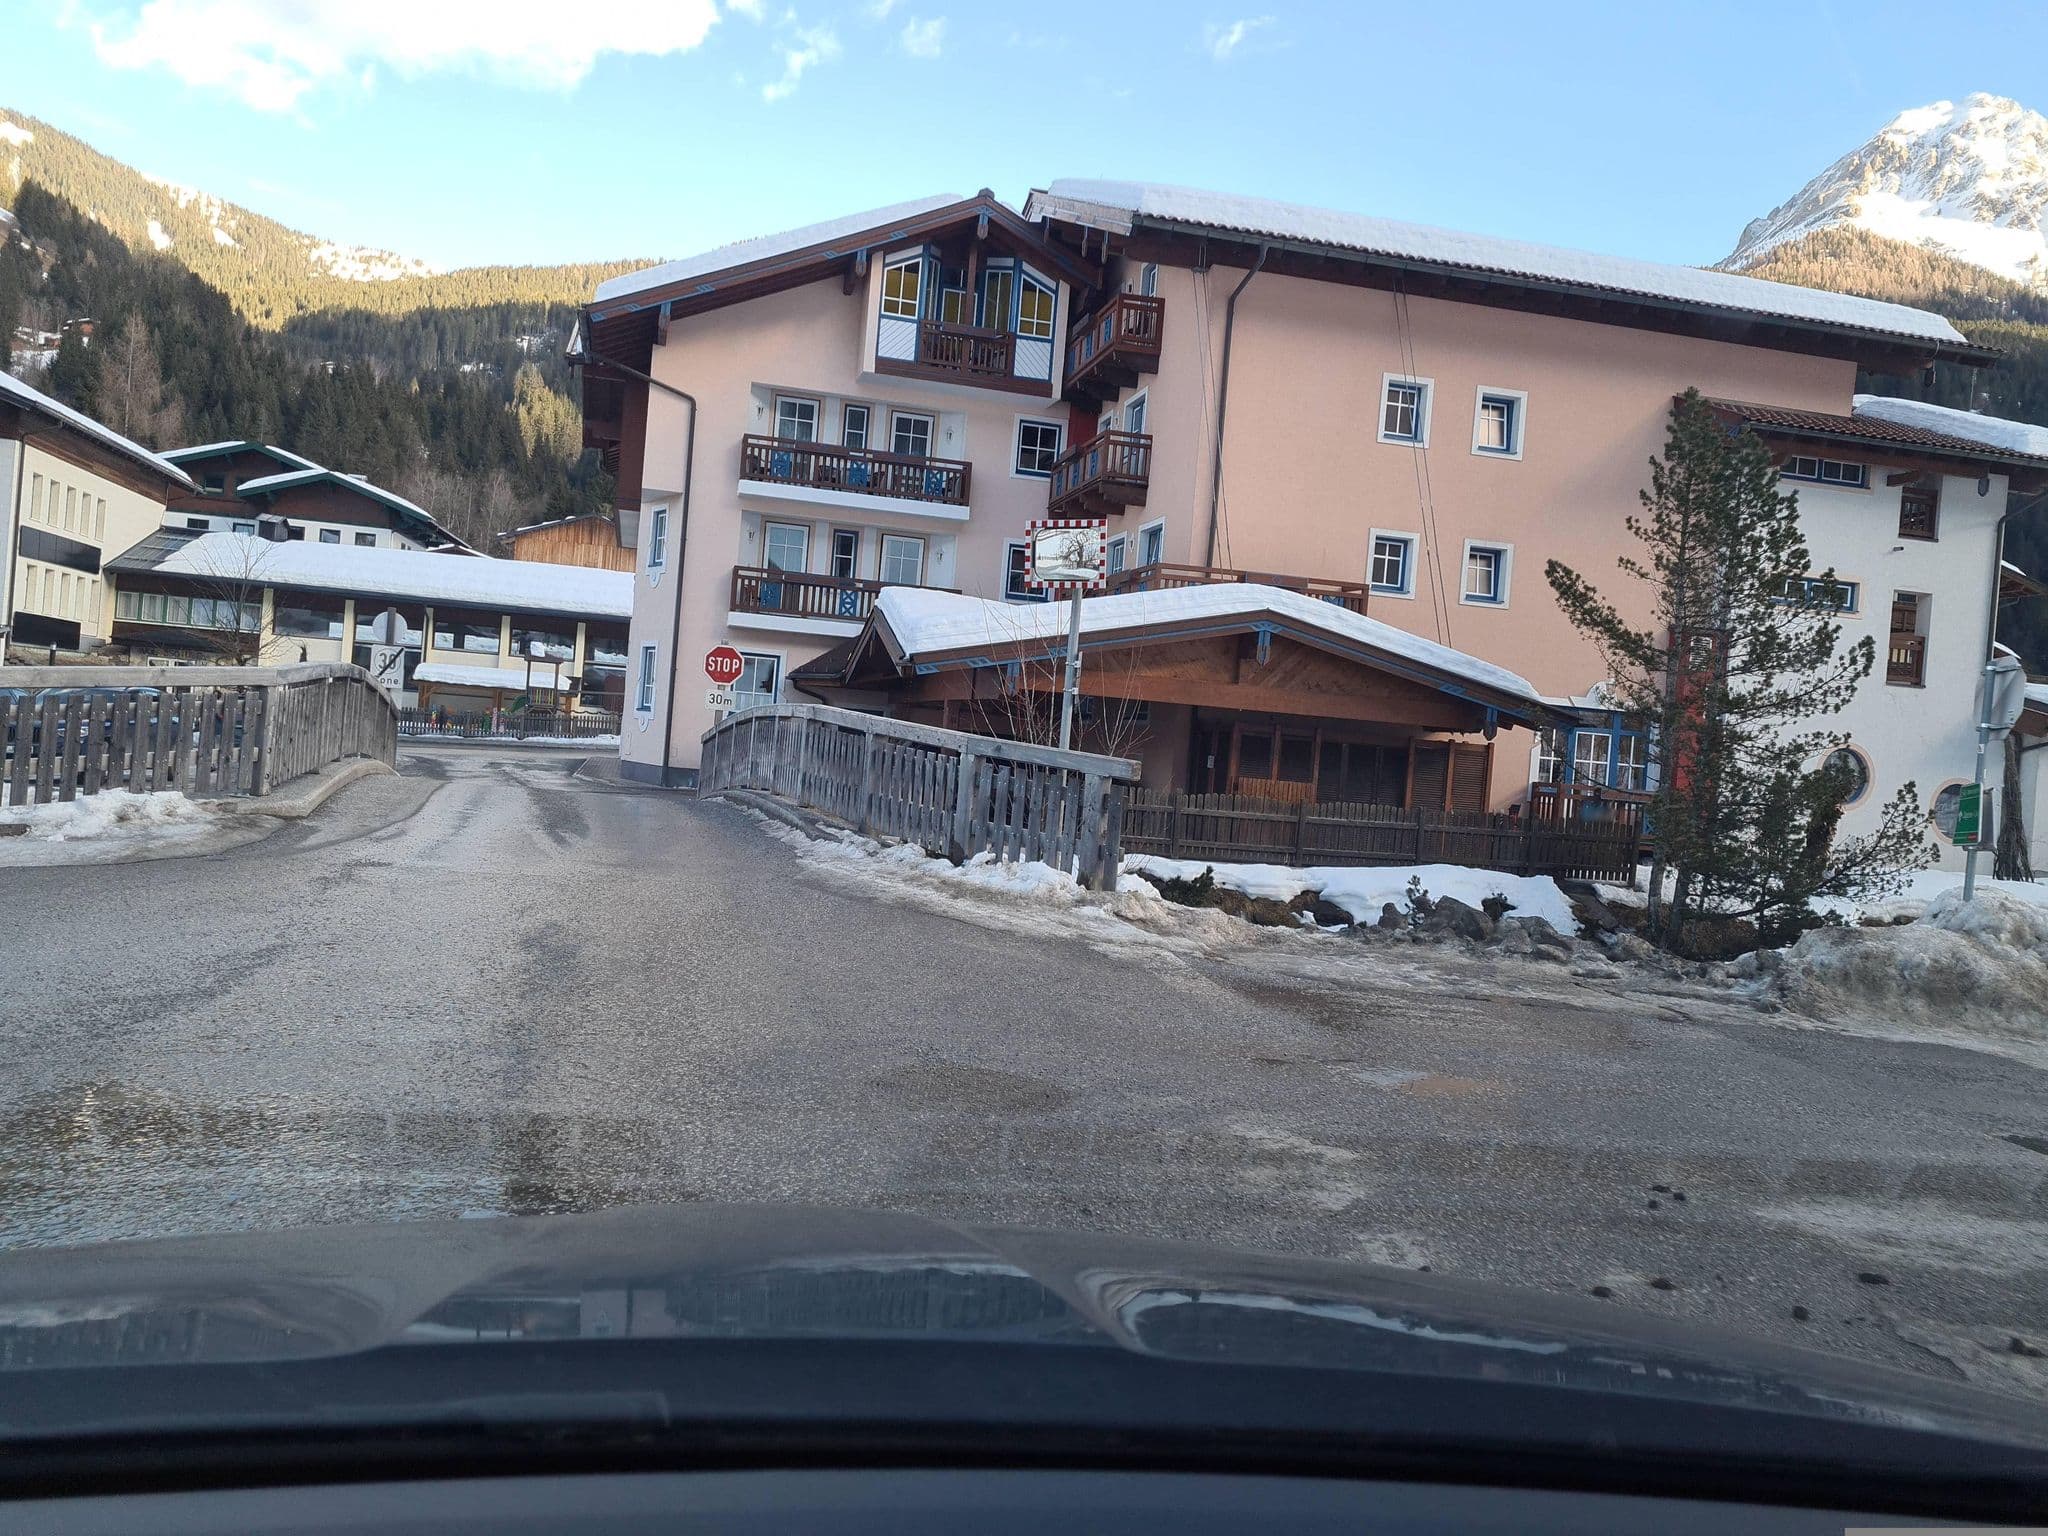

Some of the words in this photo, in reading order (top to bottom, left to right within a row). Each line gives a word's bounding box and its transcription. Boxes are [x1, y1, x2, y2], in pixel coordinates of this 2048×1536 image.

[378, 652, 397, 670] 30
[707, 656, 740, 673] STOP
[375, 675, 399, 685] one
